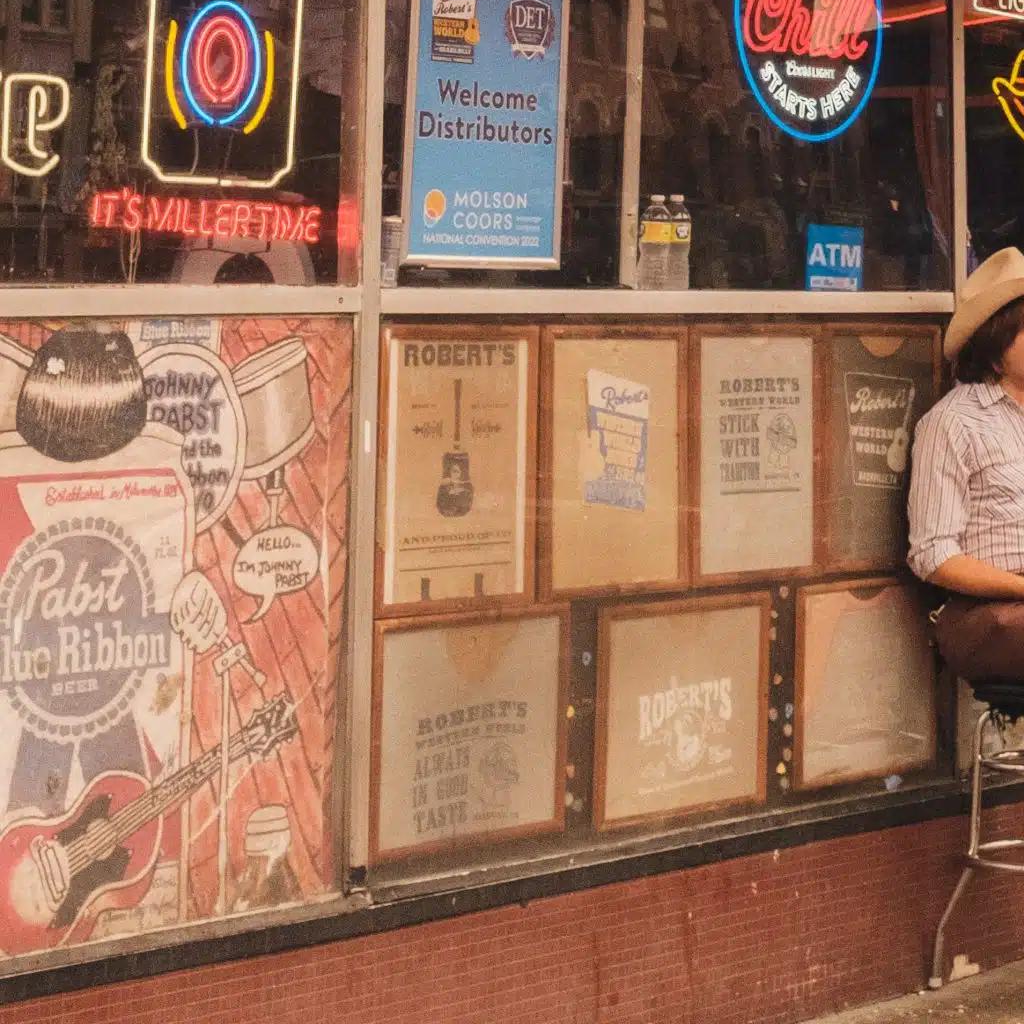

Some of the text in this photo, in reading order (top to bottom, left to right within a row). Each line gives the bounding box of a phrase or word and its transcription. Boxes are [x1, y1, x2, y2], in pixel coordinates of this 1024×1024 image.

[434, 0, 473, 16] Robert's
[514, 4, 546, 31] DET
[437, 78, 538, 112] Welcome
[760, 59, 863, 121] STARTS HERE
[418, 111, 553, 144] Distributors
[453, 190, 528, 209] MOLSON
[89, 189, 143, 231] IT'S
[147, 196, 252, 239] MILLER
[453, 211, 513, 230] COORS
[423, 233, 464, 245] NATIONAL
[464, 235, 520, 247] CONVENTION
[808, 242, 863, 268] ATM
[403, 344, 516, 367] ROBERT'S
[142, 369, 220, 403] JOHNNY
[719, 378, 800, 394] ROBERT'S
[719, 414, 760, 435] STICK
[851, 426, 894, 439] WESTERN
[719, 437, 760, 459] WITH
[855, 441, 887, 456] WORLD
[257, 559, 302, 578] JOHNNY
[275, 572, 310, 588] PABST
[20, 549, 130, 622] Pabst
[0, 624, 168, 682] lue Ribbon
[52, 678, 99, 696] BEER
[416, 701, 528, 736] ROBERT'S
[639, 677, 732, 740] ROBERT'S
[412, 801, 468, 833] TASTE
